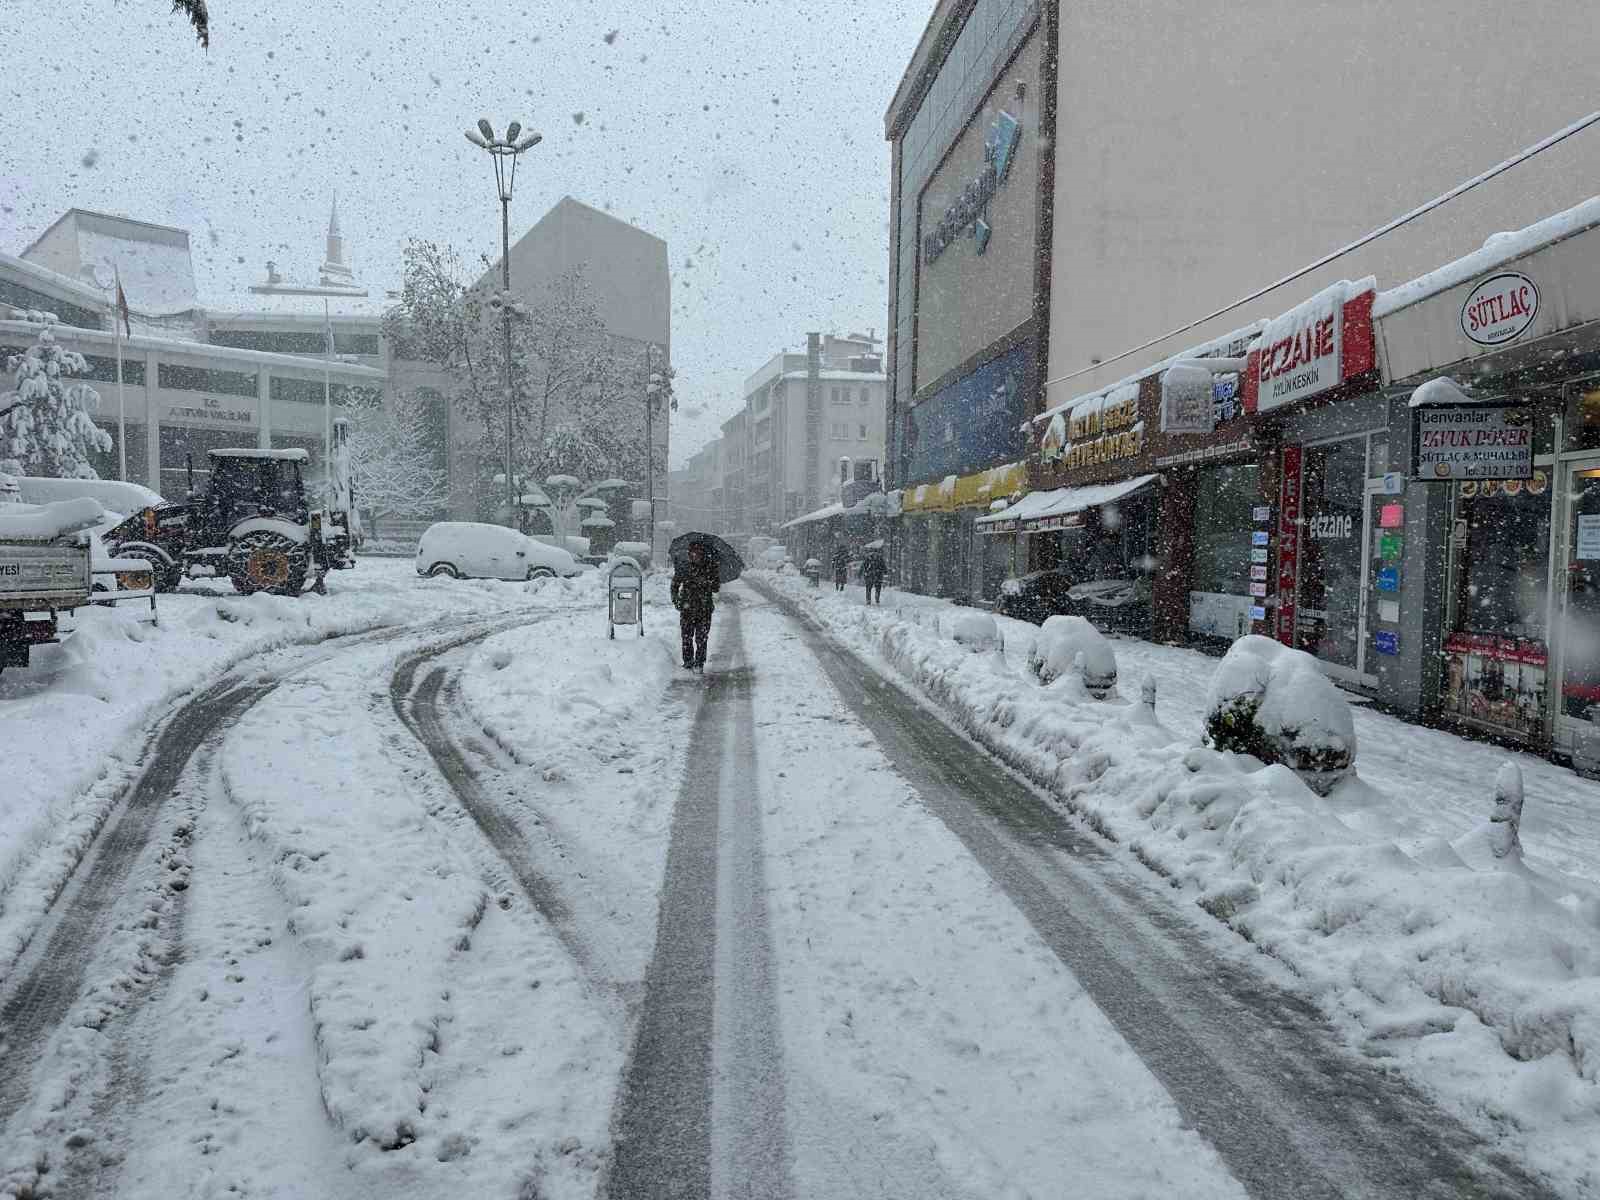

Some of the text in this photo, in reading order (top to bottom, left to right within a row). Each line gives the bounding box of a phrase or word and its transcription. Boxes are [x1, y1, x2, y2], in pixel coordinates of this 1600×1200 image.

[1467, 286, 1531, 332] SÜTLAÇ
[1273, 366, 1319, 399] AYLİN KESKİN
[1423, 427, 1528, 448] TAVUK DÖNER
[1309, 513, 1352, 539] eczane
